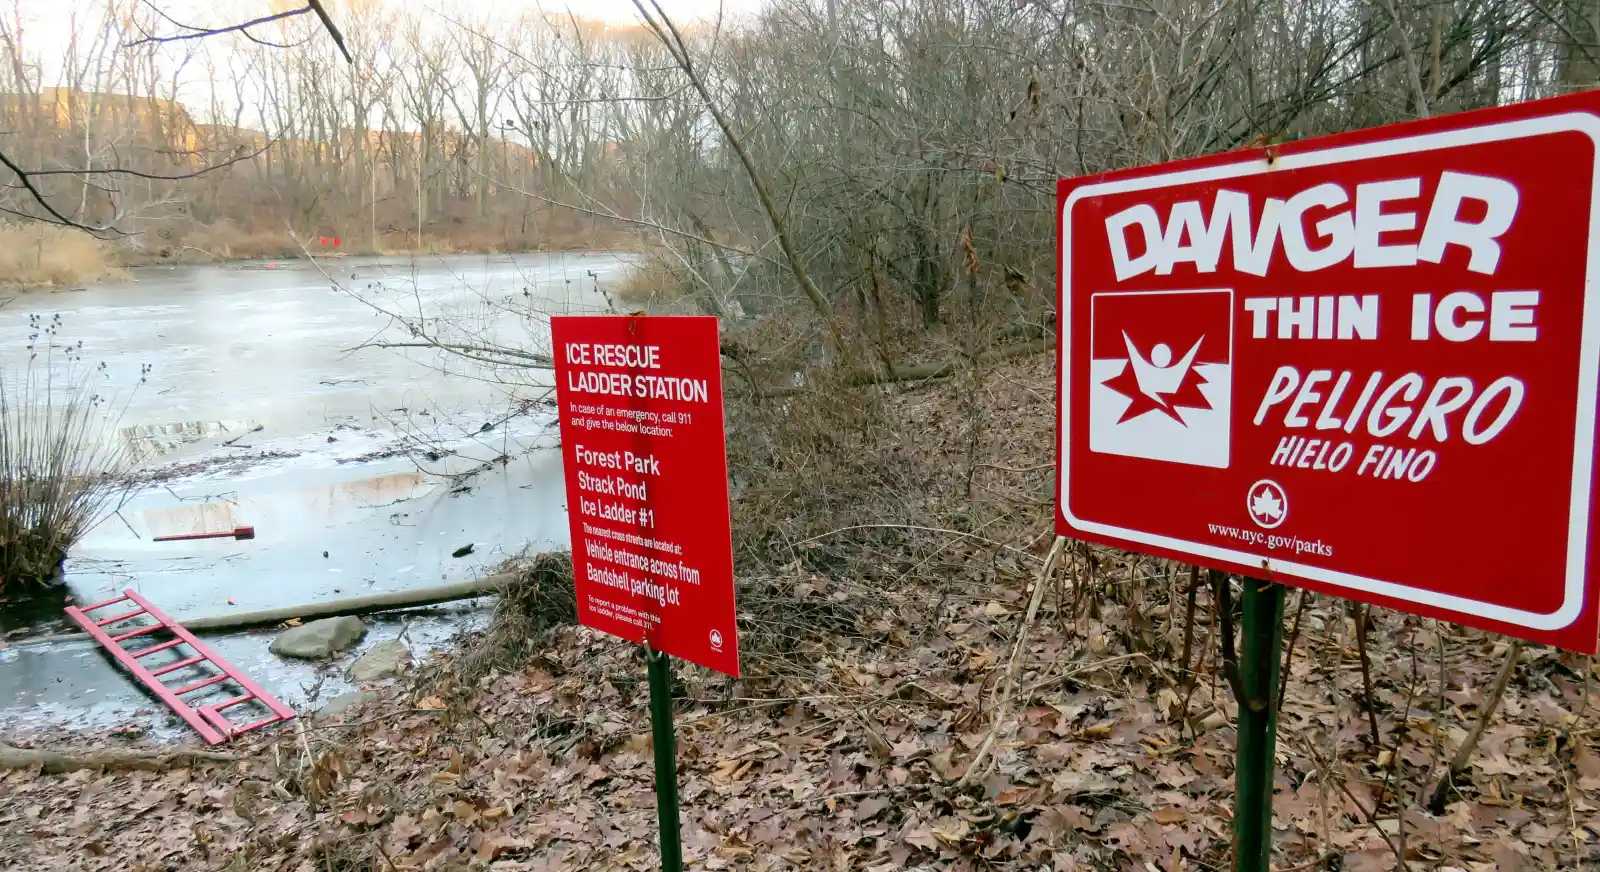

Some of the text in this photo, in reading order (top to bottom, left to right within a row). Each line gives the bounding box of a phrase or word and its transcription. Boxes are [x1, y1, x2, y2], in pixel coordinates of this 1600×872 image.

[1104, 170, 1520, 282] DANGER
[1244, 290, 1540, 342] THIN ICE
[565, 342, 661, 369] ICE RESCUE
[567, 371, 709, 403] LADDER STATION
[570, 401, 692, 425] In case of an emergency, call 911
[1252, 366, 1525, 446] PELIGRO
[571, 415, 673, 437] and give the below location:
[575, 444, 660, 476] Forest Park
[1270, 435, 1437, 482] HIELO FINO
[578, 470, 647, 501] Strack Pond
[580, 495, 654, 529] Ice Ladder #1
[582, 521, 682, 556] The nearest cross streets are located at:
[1208, 523, 1333, 557] www.nyc.gov/parks
[585, 538, 700, 585] Vehicle entrance across from
[586, 562, 680, 608] Bandshell parking lot
